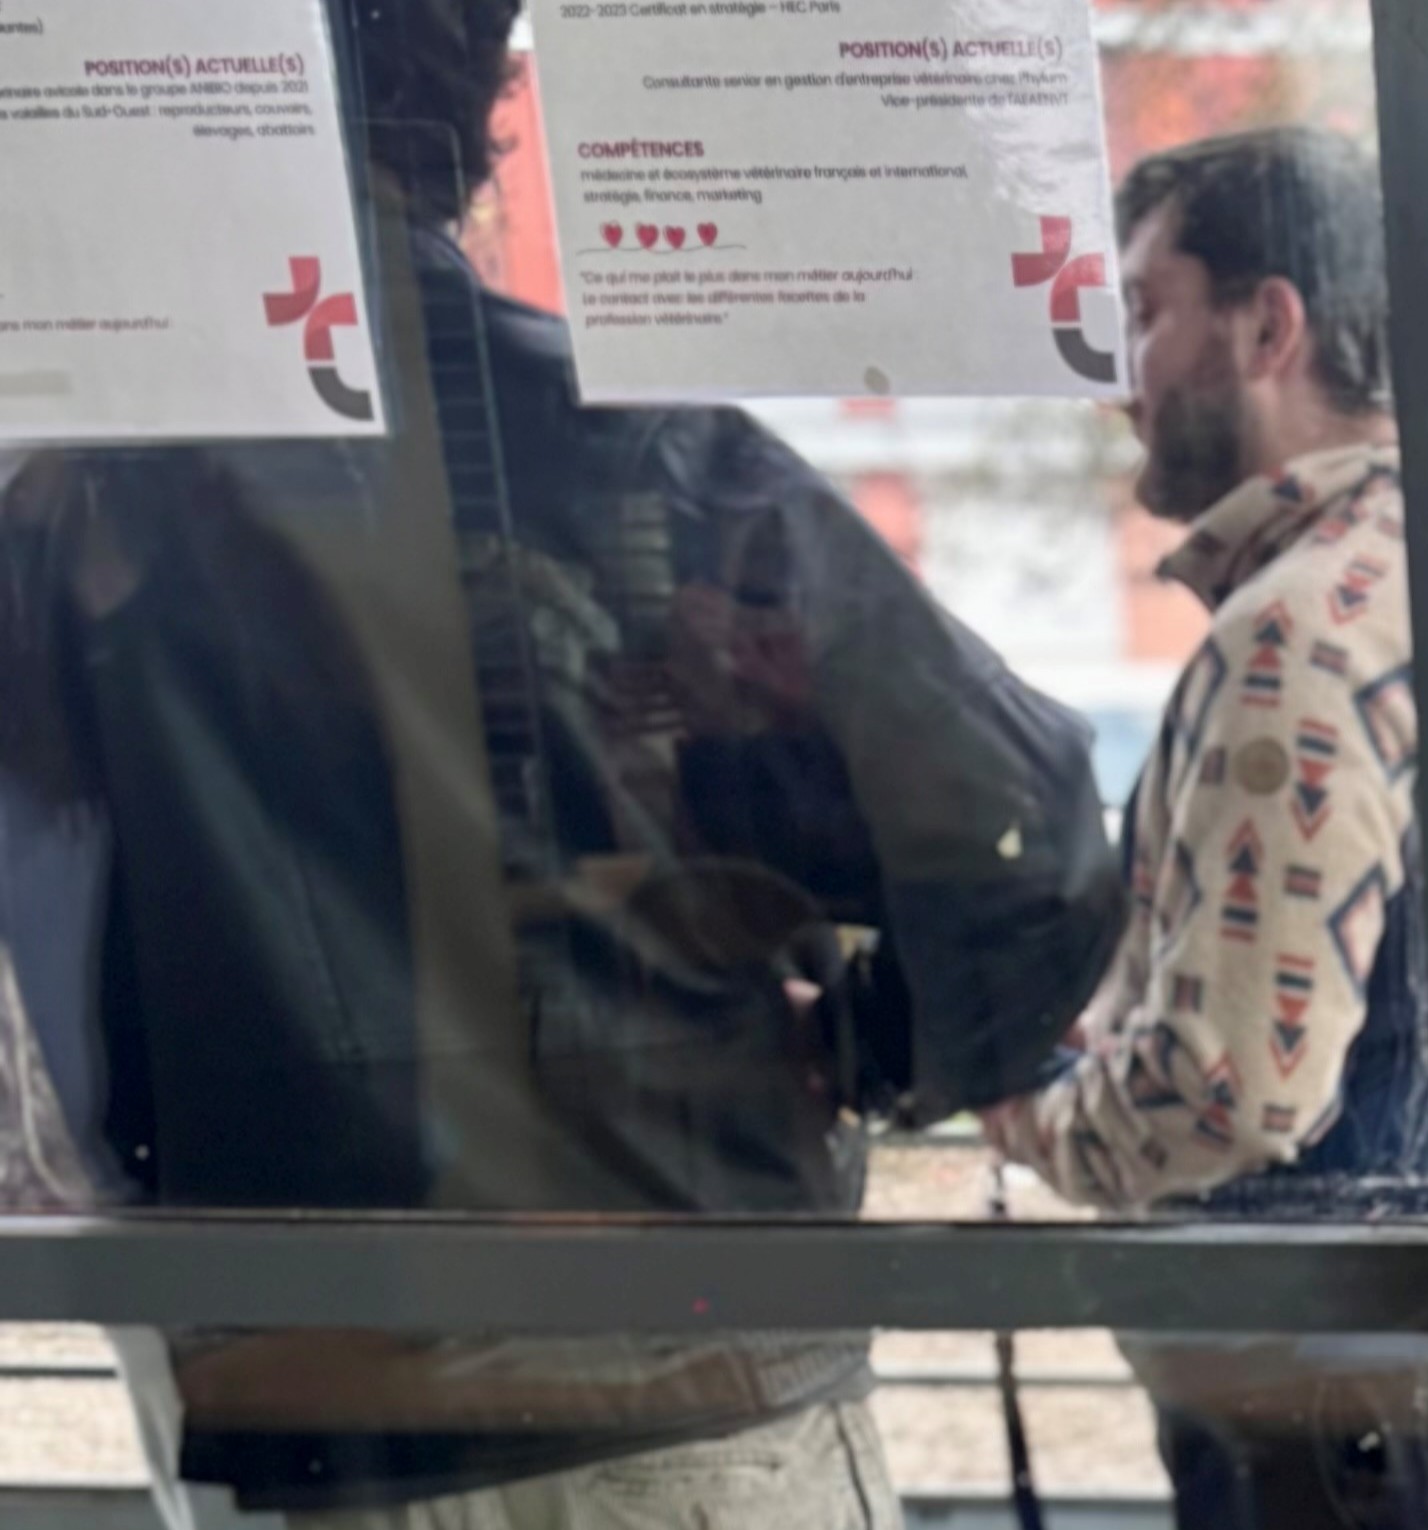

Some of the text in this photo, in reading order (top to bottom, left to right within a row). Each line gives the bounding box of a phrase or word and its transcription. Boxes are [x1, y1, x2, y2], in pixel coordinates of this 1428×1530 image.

[690, 3, 707, 15] en
[809, 0, 841, 13] Paris
[839, 35, 1063, 62] POSITION(S) ACTUELLE(S)
[84, 53, 304, 78] POSITION(S) ACTUELLE(S)
[91, 83, 125, 97] dans
[126, 82, 139, 96] le
[140, 83, 188, 99] groupe
[643, 75, 721, 89] Consultante
[723, 75, 762, 88] senior
[764, 75, 782, 87] en
[784, 73, 832, 90] gestion
[577, 137, 705, 159] COMPÉTENCES
[581, 167, 646, 182] médecine
[648, 167, 660, 181] et
[814, 163, 866, 181] français
[869, 165, 882, 178] et
[696, 187, 763, 205] marketing
